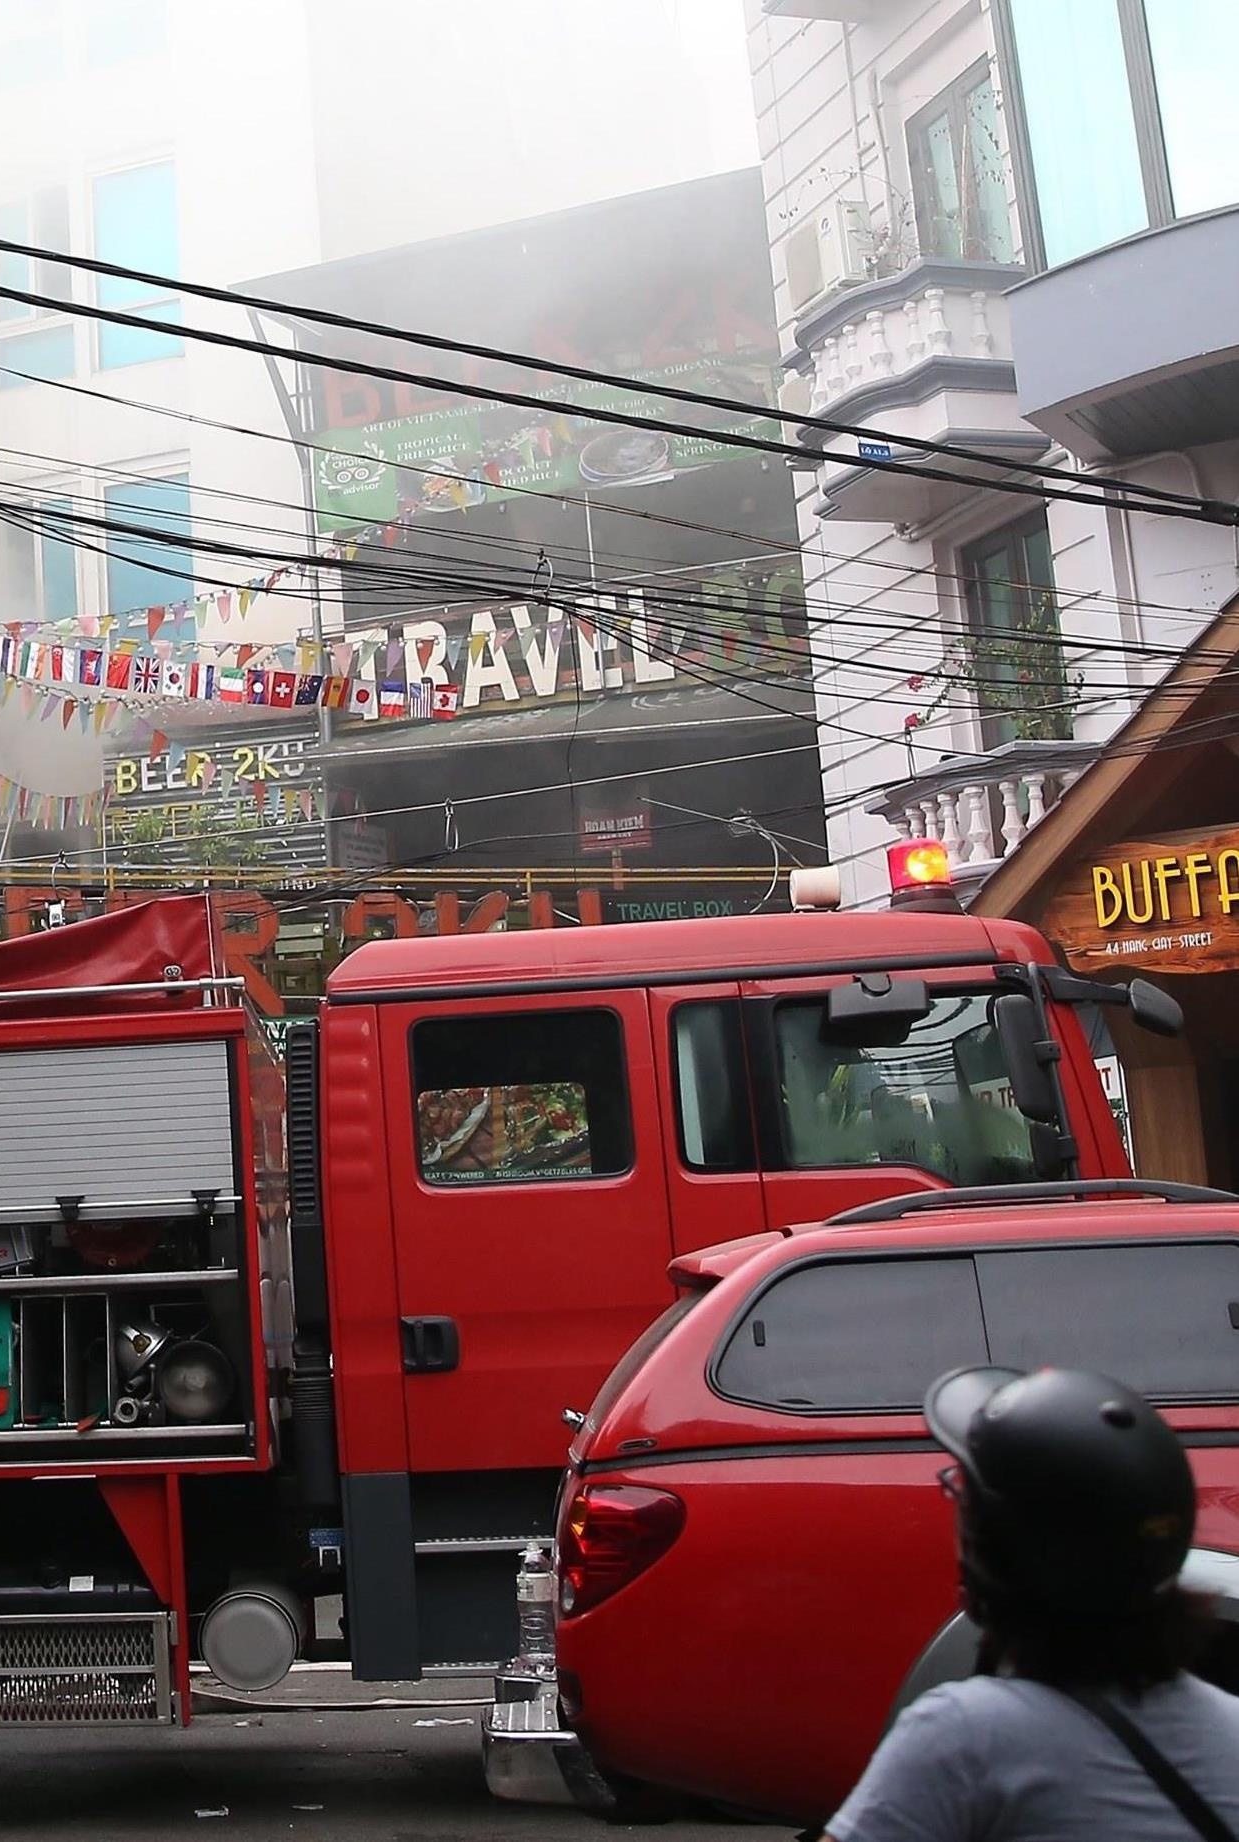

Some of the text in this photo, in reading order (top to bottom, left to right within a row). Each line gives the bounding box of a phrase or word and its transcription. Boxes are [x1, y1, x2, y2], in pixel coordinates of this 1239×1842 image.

[396, 432, 463, 451] TROPICAL
[396, 441, 472, 463] FRIED RICE
[344, 587, 677, 721] TRAVEL
[115, 750, 216, 795] BEER
[616, 899, 734, 922] TRAVEL BOX
[1105, 942, 1120, 956] 44
[1122, 939, 1149, 953] HANG
[1178, 931, 1213, 949] STREET
